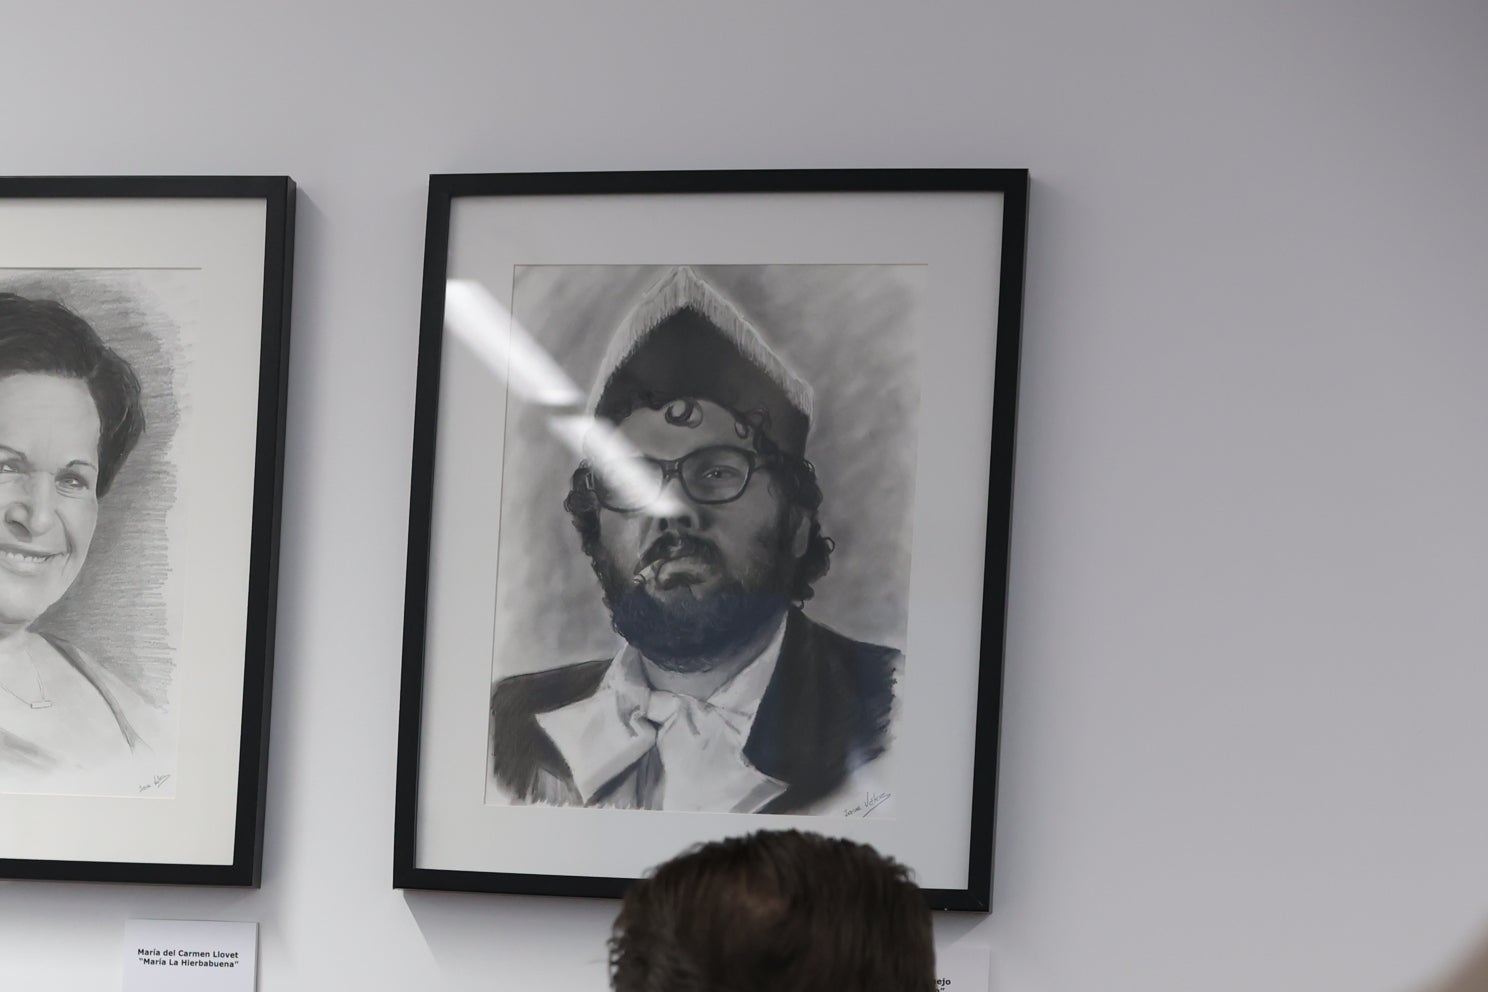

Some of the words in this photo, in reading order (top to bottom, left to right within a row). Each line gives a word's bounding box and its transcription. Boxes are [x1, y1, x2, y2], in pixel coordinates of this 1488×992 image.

[137, 948, 161, 956] María
[163, 949, 176, 957] del
[178, 949, 211, 958] Carmen
[213, 950, 239, 959] Llovet
[181, 959, 239, 968] Hierbabuena"
